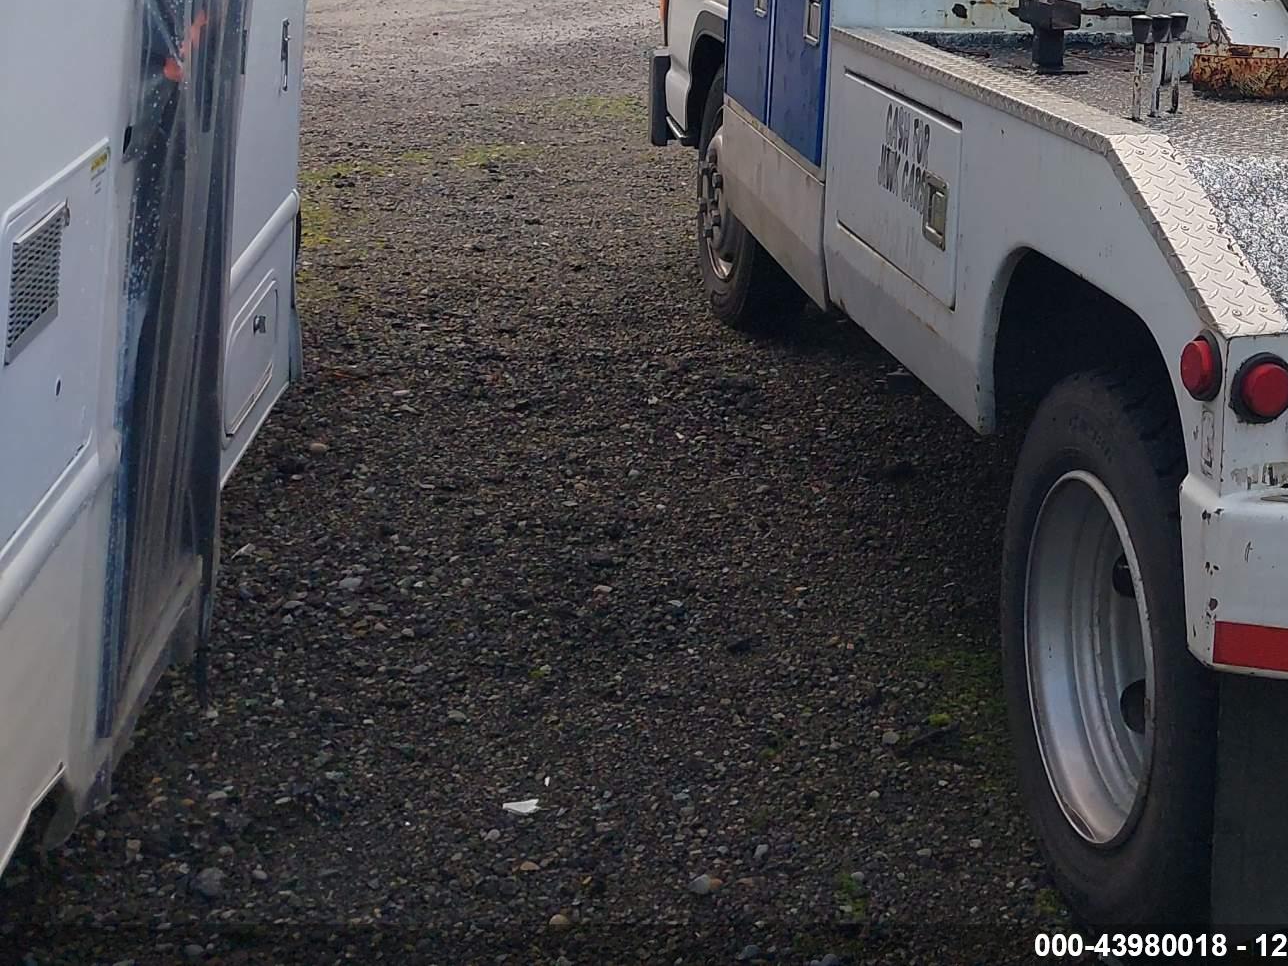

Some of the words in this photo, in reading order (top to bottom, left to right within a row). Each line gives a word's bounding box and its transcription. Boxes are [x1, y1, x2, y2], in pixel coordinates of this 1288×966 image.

[886, 103, 911, 157] CASH
[911, 118, 931, 170] FOR
[878, 143, 901, 197] JUNK
